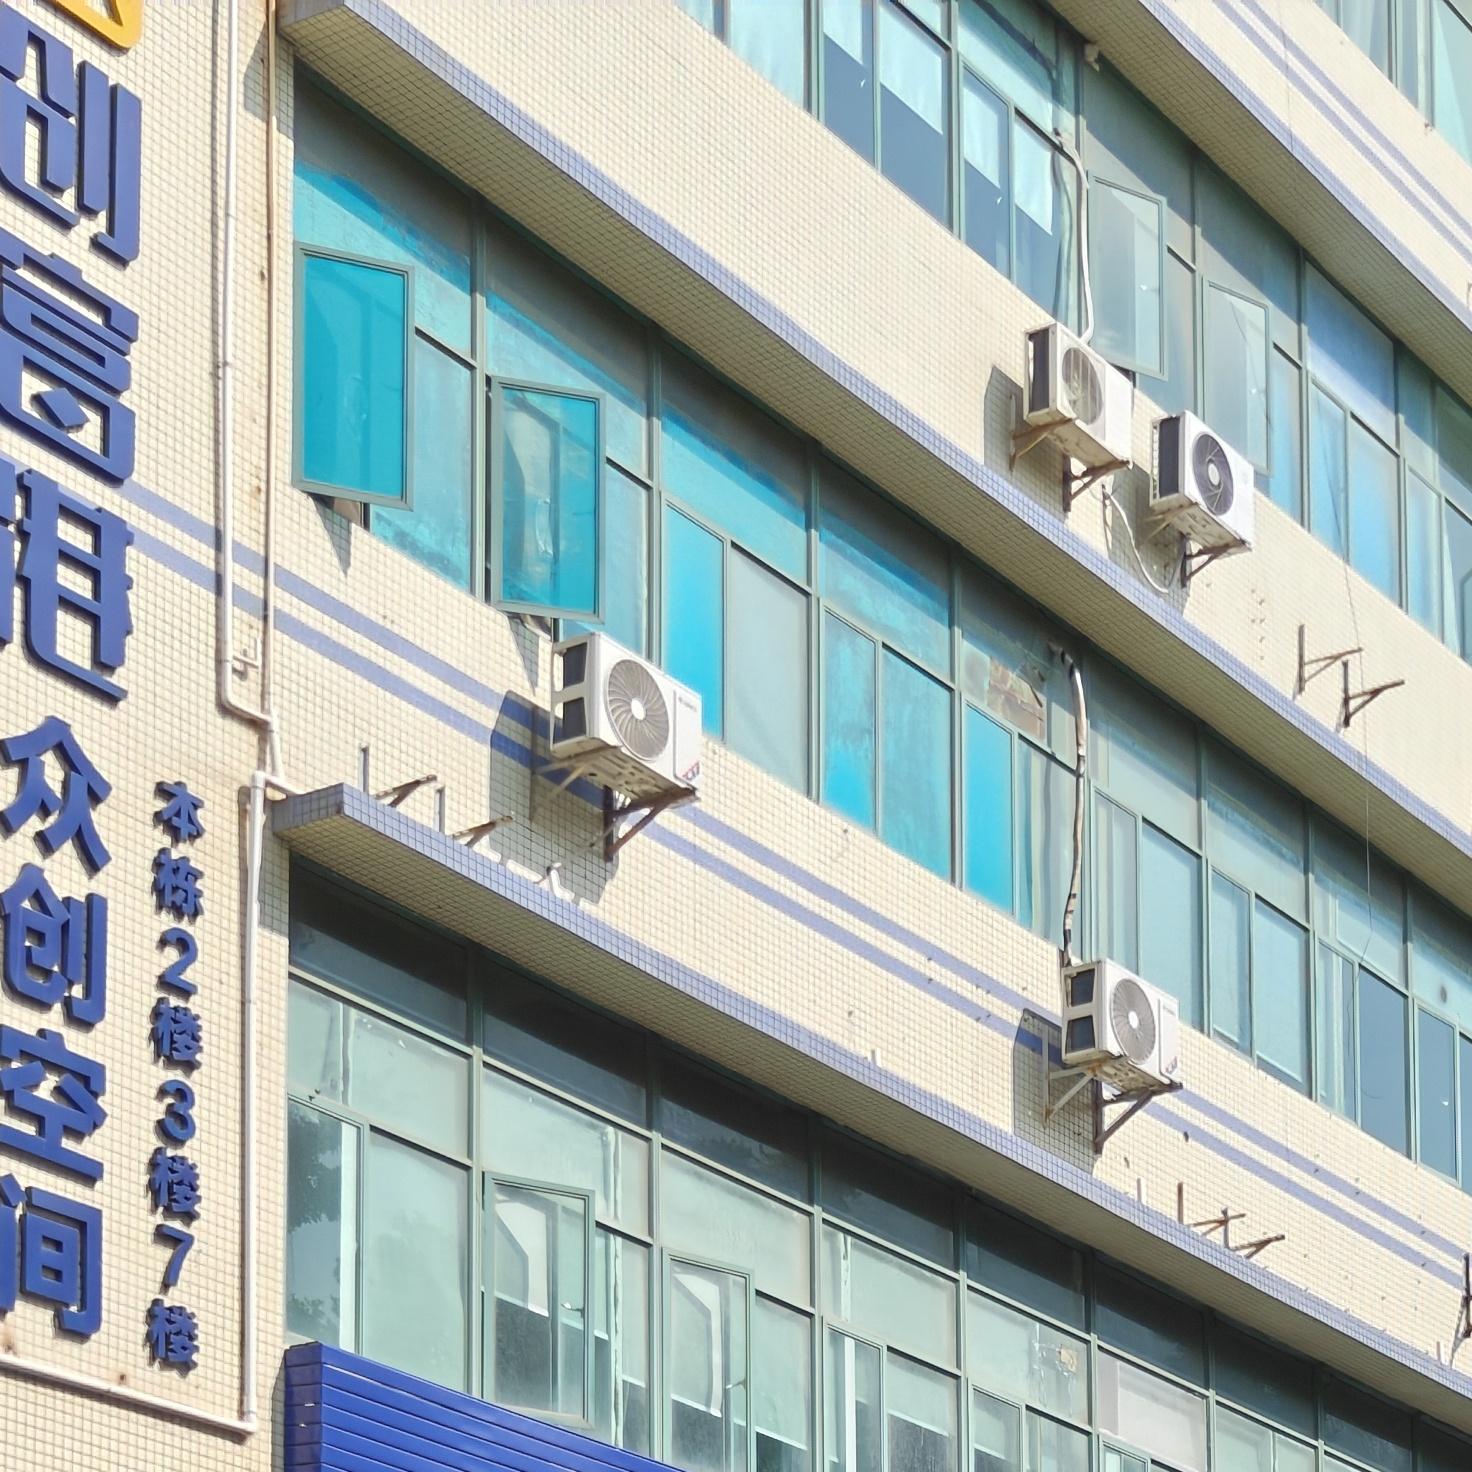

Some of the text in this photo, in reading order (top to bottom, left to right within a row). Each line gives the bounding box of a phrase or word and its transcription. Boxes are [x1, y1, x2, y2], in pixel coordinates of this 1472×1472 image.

[146, 780, 206, 1378] 本栋2楼3楼7楼
